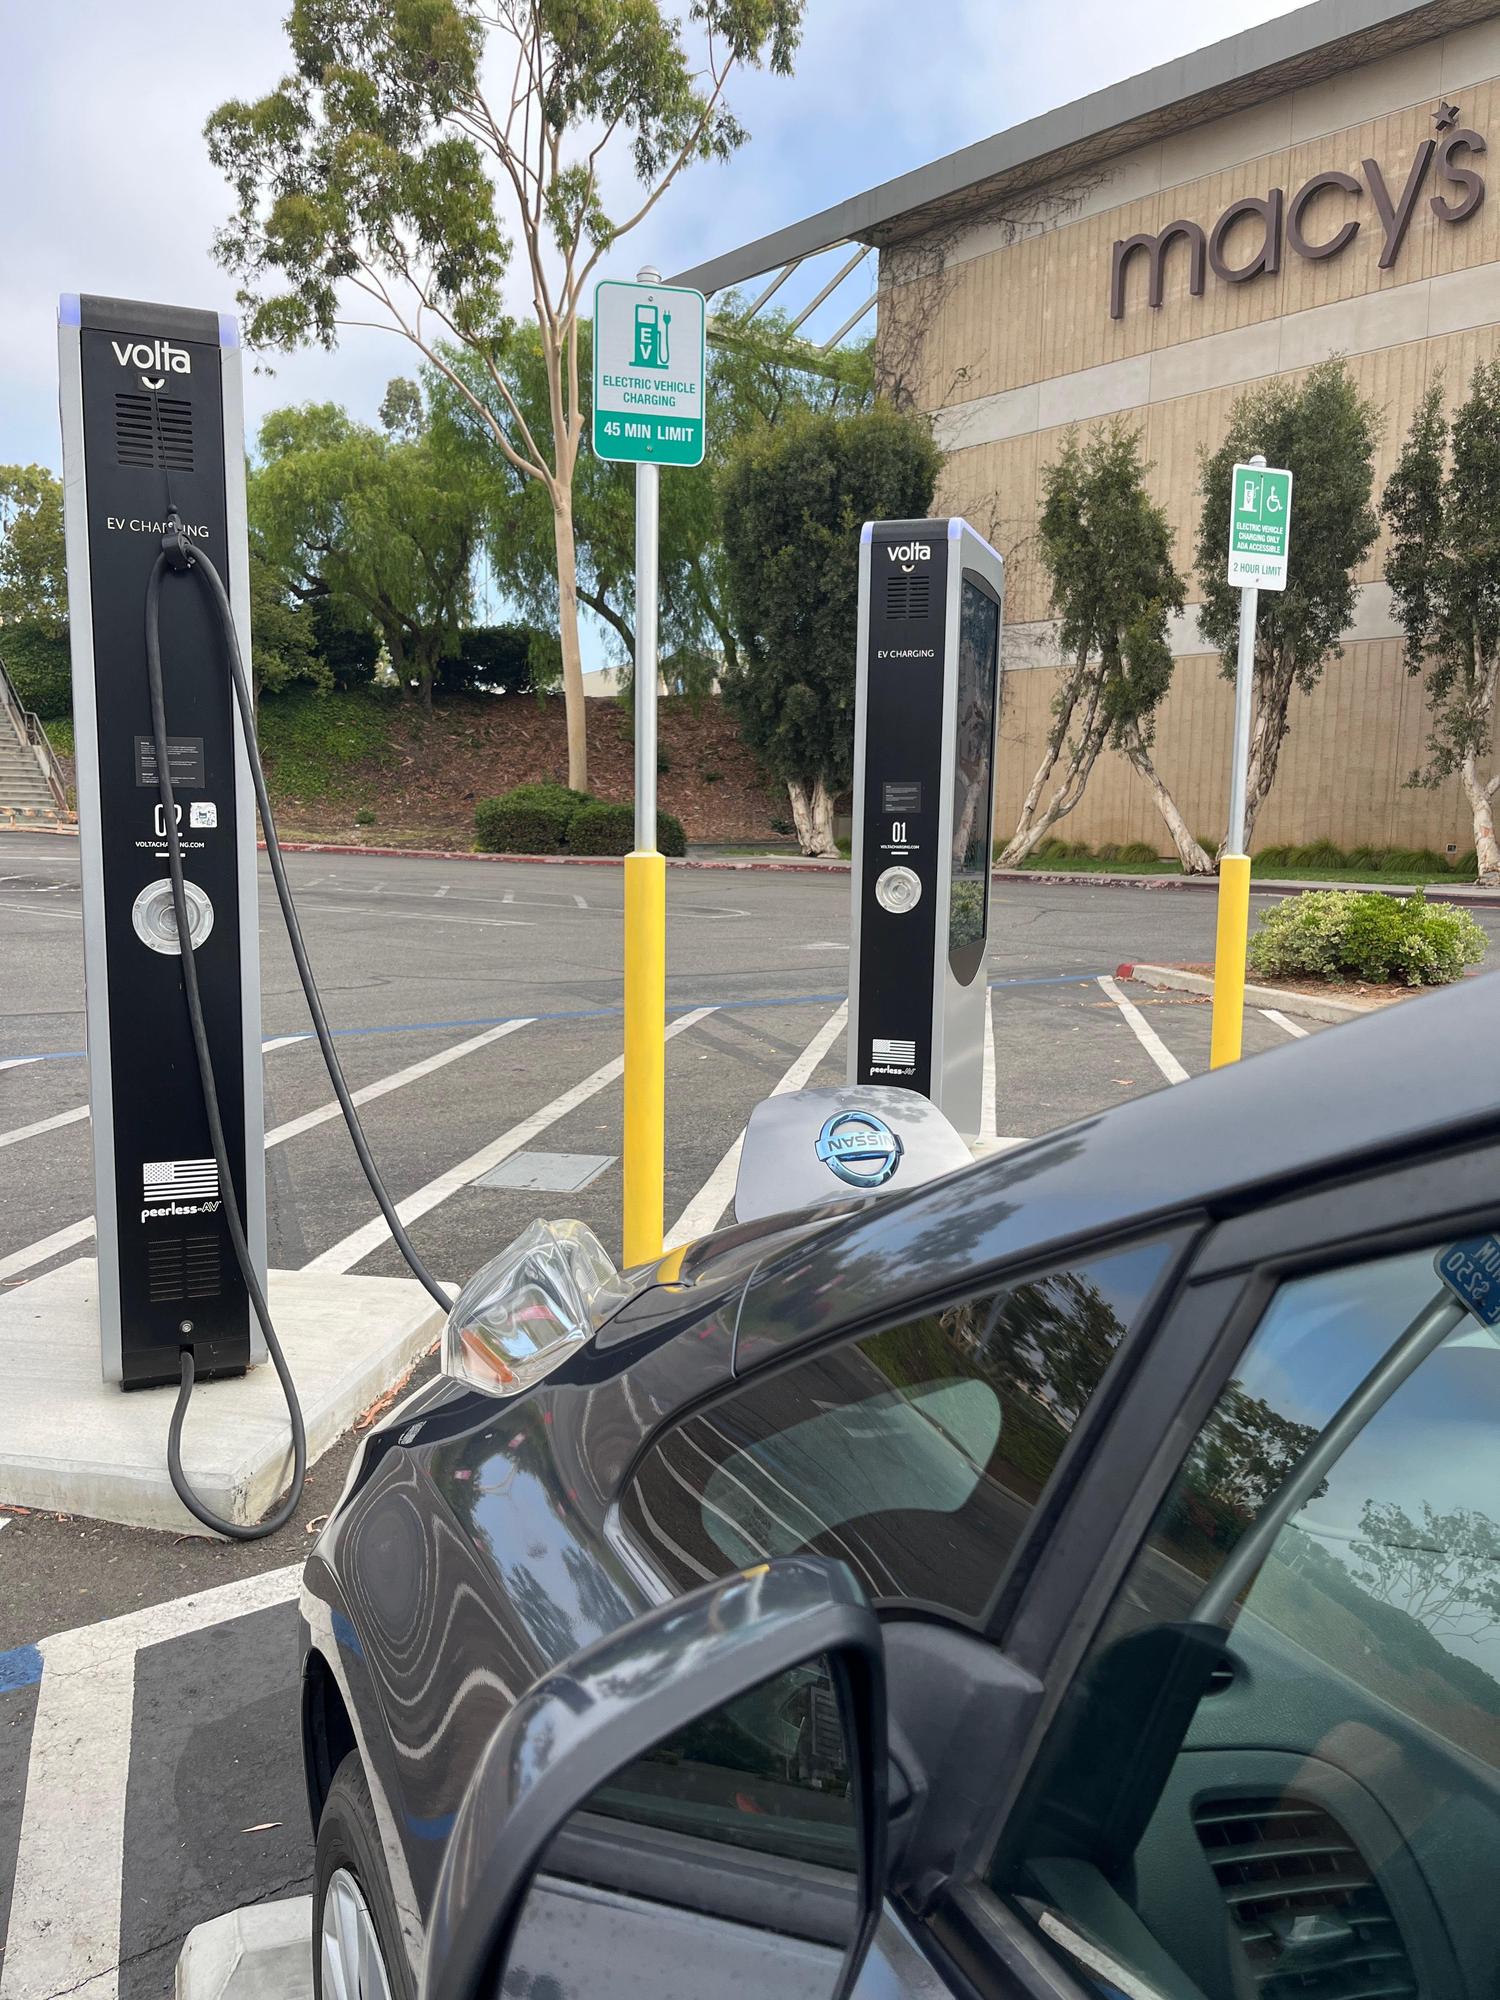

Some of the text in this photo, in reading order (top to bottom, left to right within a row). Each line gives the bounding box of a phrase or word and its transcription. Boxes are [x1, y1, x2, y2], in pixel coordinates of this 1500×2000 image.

[111, 340, 191, 374] volta
[603, 375, 696, 394] ELECTRIC VEHICLE
[623, 392, 676, 407] CHARGING
[604, 421, 695, 442] 45 MIN LIMIT
[107, 517, 126, 530] EV
[1236, 521, 1284, 535] ELECTRIC VEHICLE
[1238, 532, 1281, 544] CHARGING ONLY
[887, 541, 931, 562] volta
[1236, 541, 1281, 554] ADA ACCESSIBLE
[1233, 562, 1282, 577] 2 HOUR LIMIT
[877, 649, 935, 659] EV CHARGING
[892, 821, 908, 843] 01
[827, 1132, 894, 1152] NISSAN
